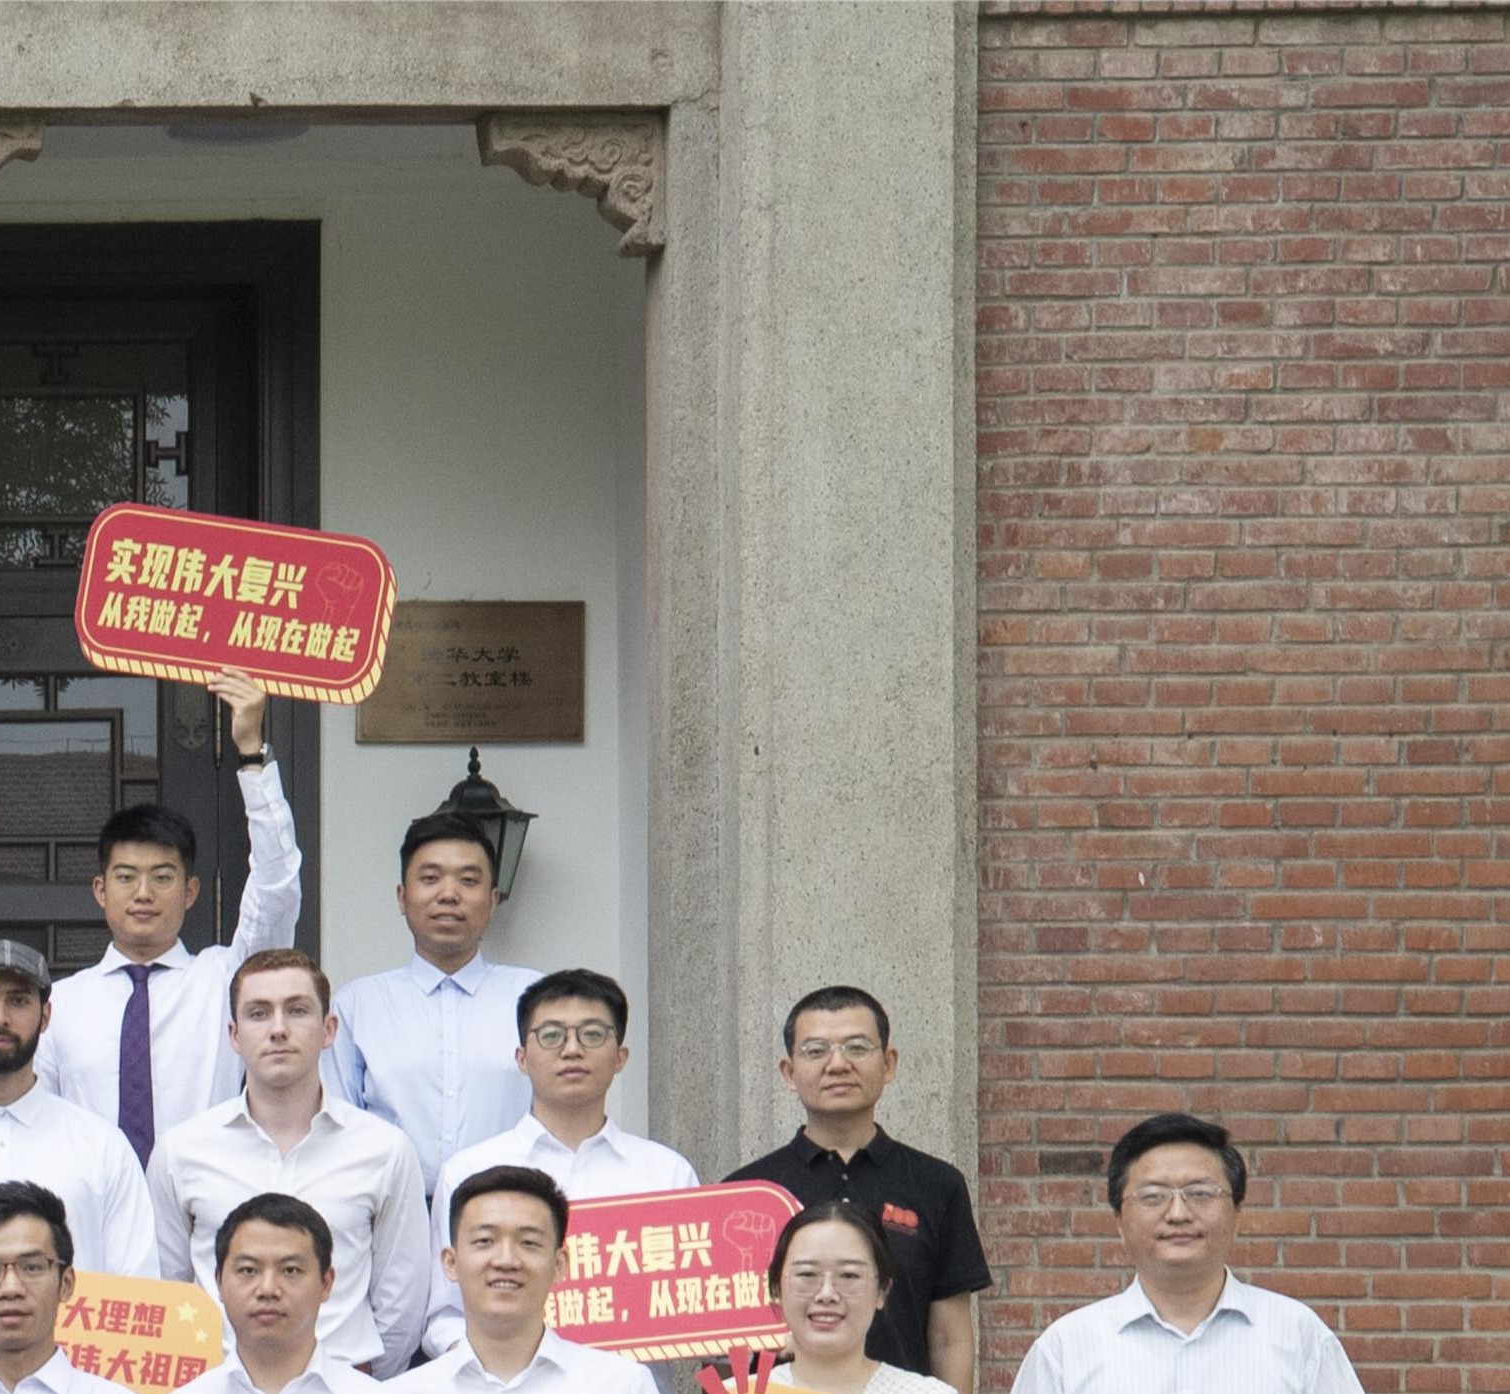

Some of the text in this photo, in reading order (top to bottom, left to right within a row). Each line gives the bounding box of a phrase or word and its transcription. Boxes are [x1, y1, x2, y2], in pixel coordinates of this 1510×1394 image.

[105, 538, 310, 610] 实现伟大复兴
[421, 646, 520, 663] 华大学
[412, 671, 533, 688] 二教室楼
[562, 1222, 713, 1281] 伟大复兴
[54, 1296, 167, 1338] 大理想
[54, 1341, 208, 1388] 伟大祖国
